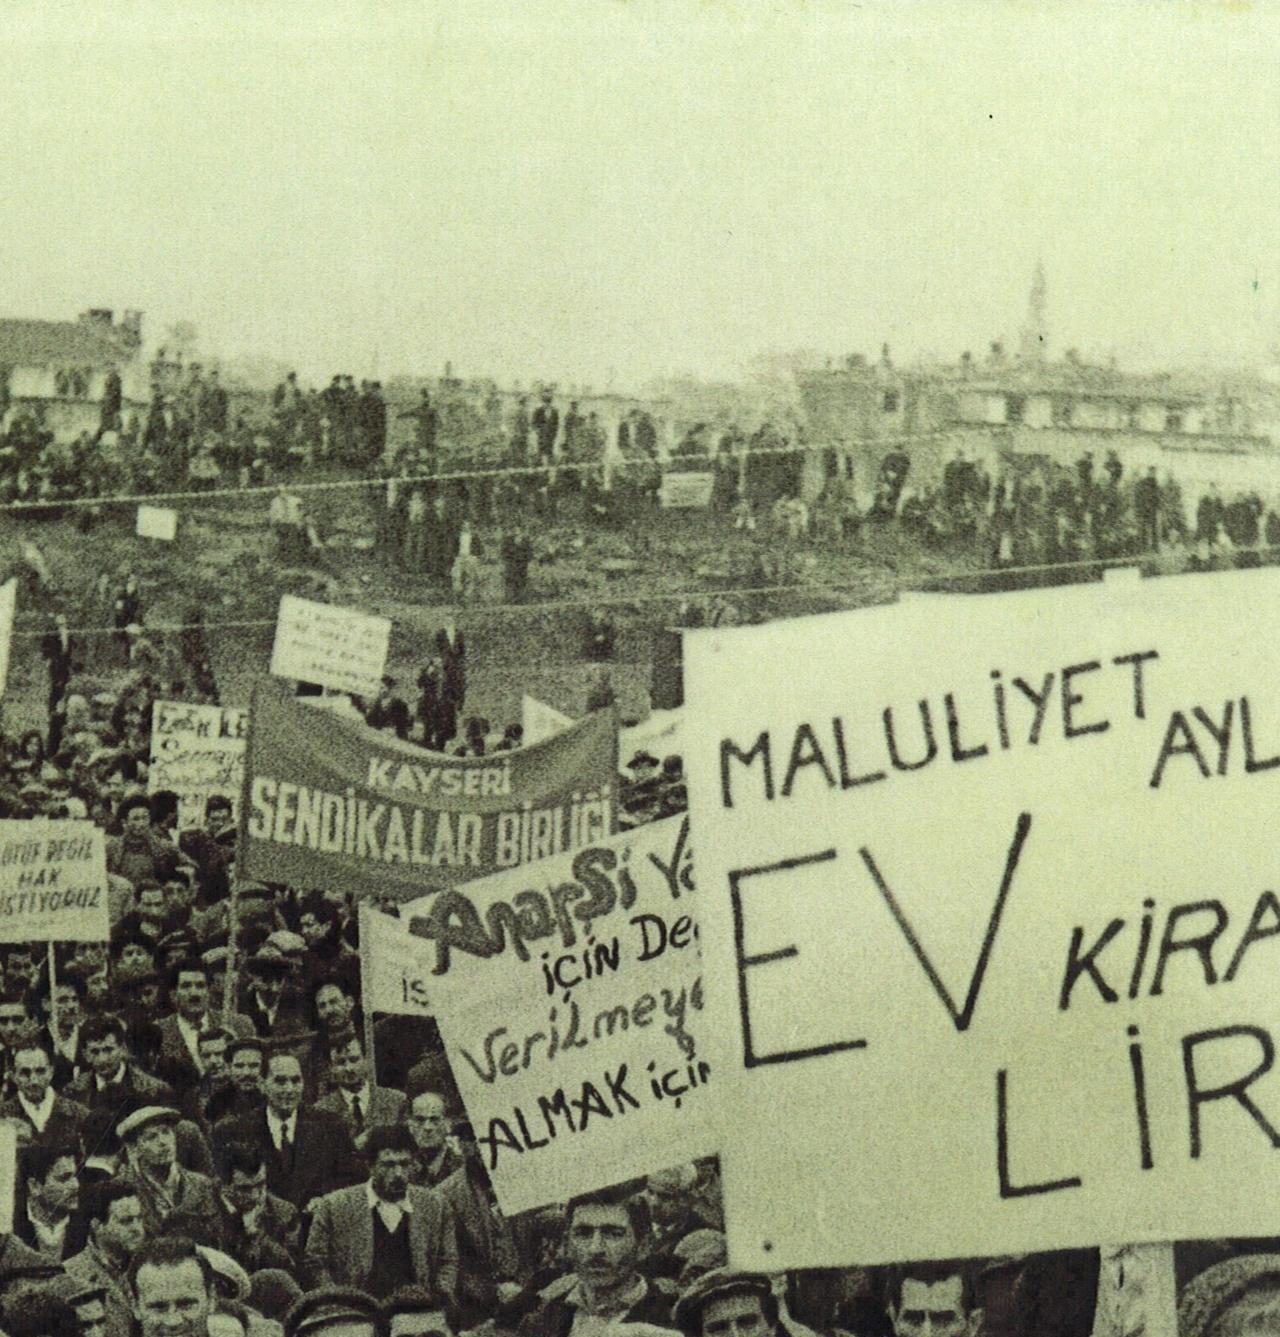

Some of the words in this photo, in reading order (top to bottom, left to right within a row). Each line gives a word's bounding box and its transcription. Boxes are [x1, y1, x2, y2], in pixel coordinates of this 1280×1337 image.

[365, 753, 513, 798] KAYSERİ
[718, 650, 1160, 810] MALULİYET
[246, 776, 485, 868] SENDİKALAR
[630, 913, 702, 962] De
[728, 811, 1034, 1070] EV
[478, 1063, 642, 1170] ALMAK
